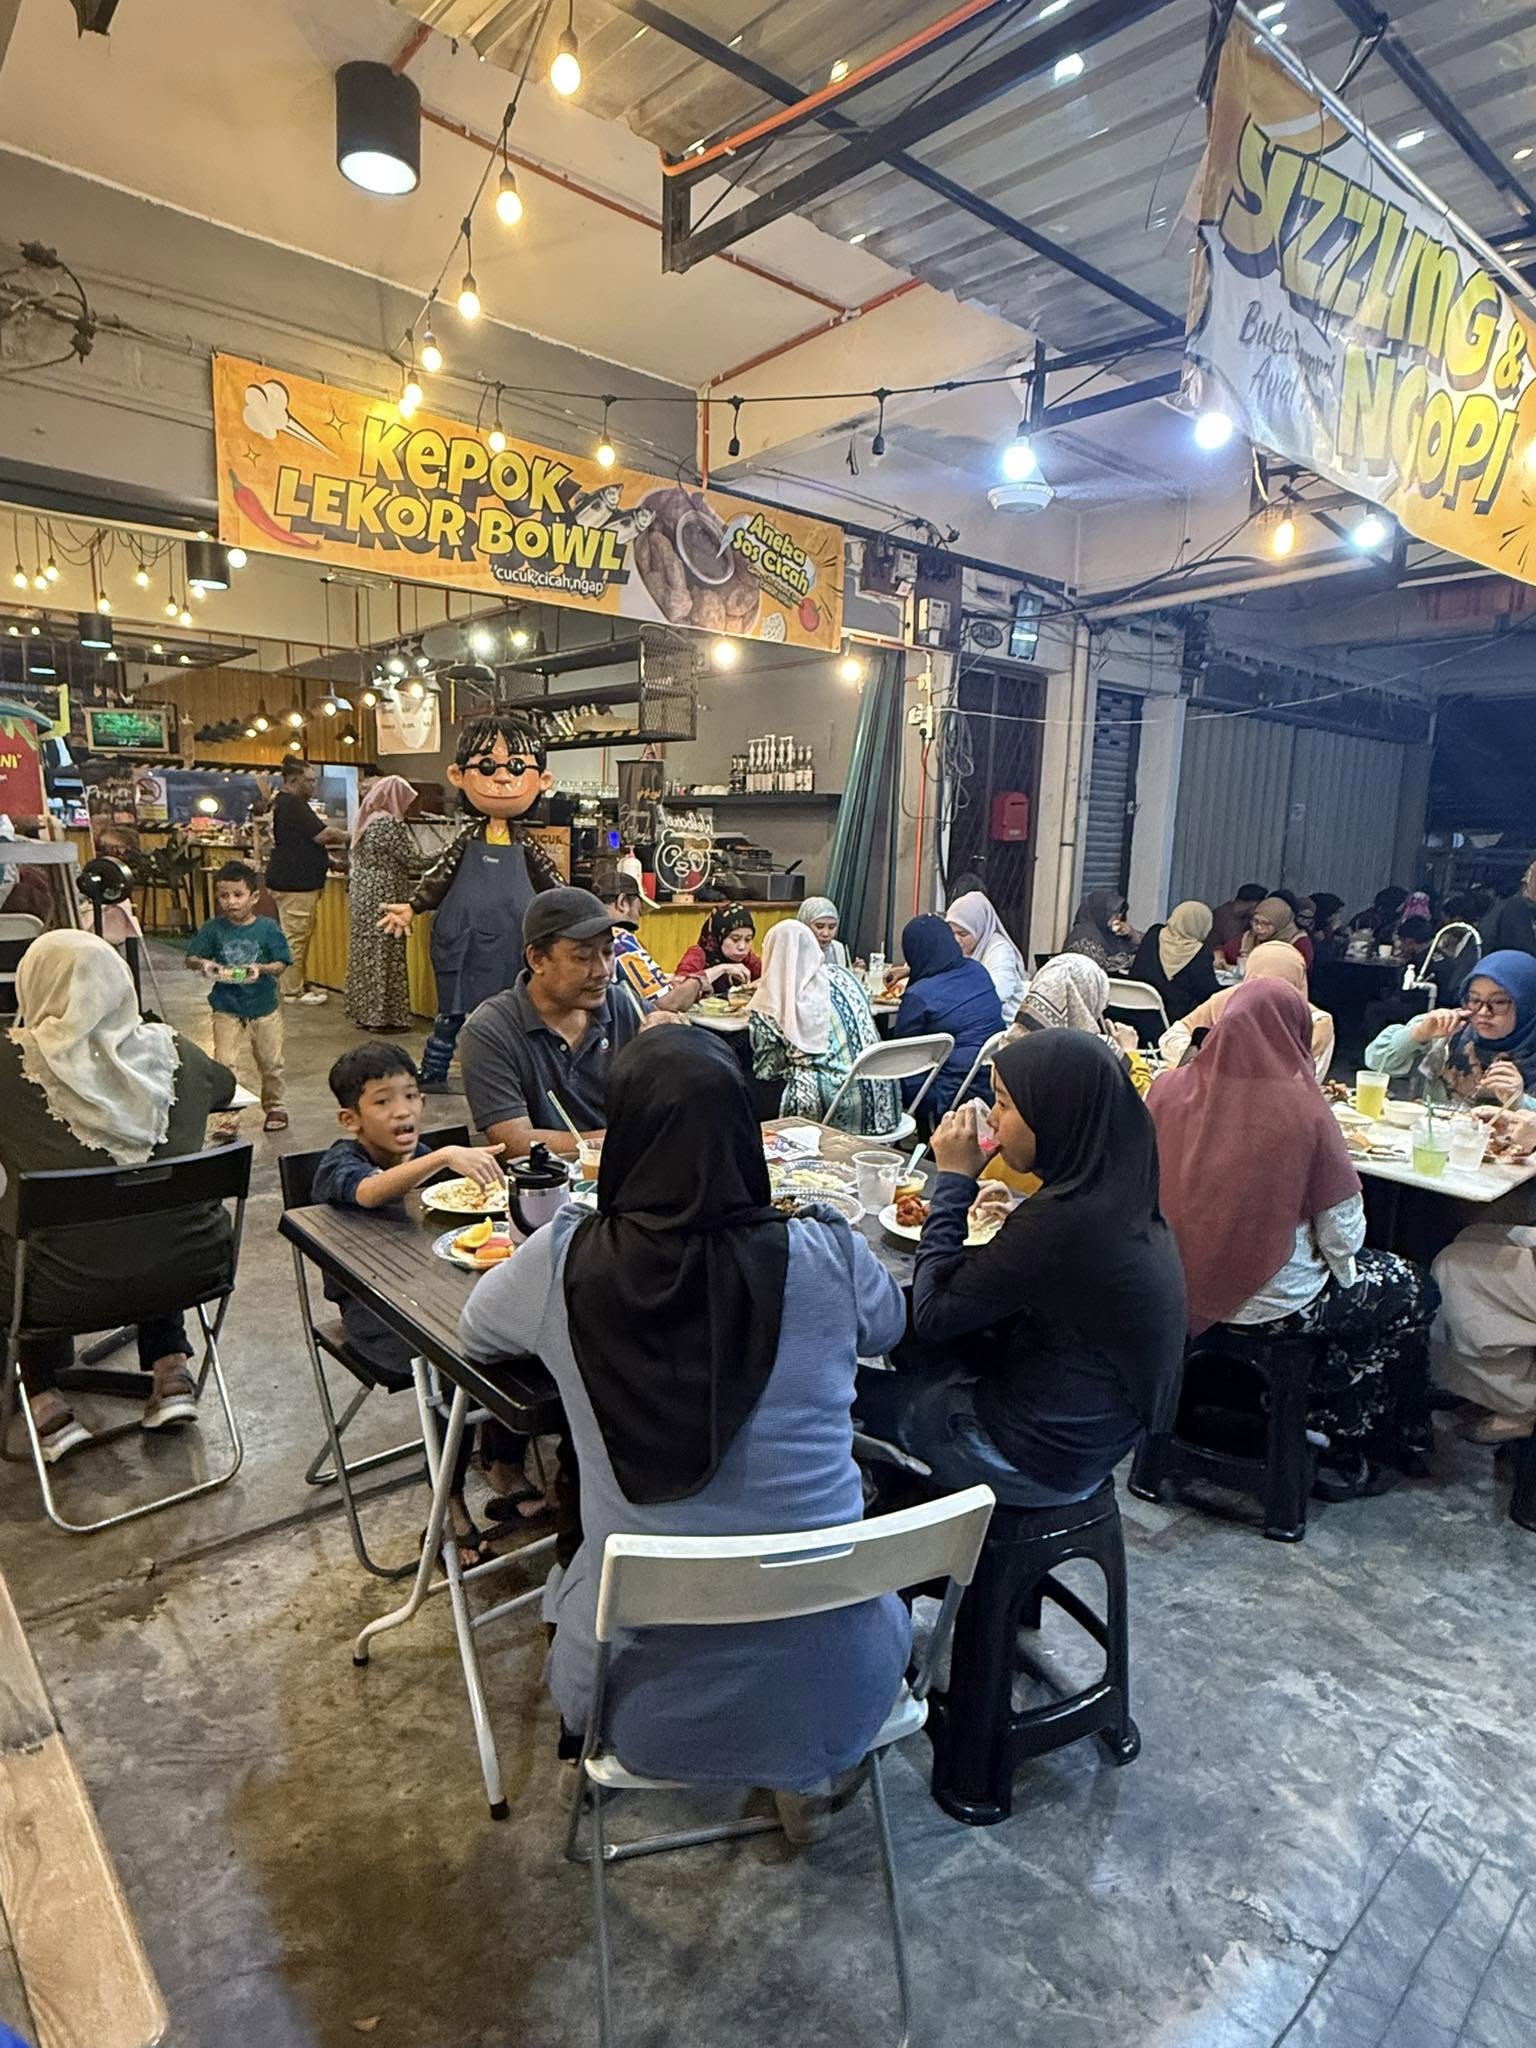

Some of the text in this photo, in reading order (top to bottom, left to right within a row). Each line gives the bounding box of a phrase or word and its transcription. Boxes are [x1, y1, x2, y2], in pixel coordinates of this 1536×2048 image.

[1337, 342, 1519, 504] NGOPI
[274, 465, 628, 571] LEKOR BOWL
[731, 527, 760, 563] Sos
